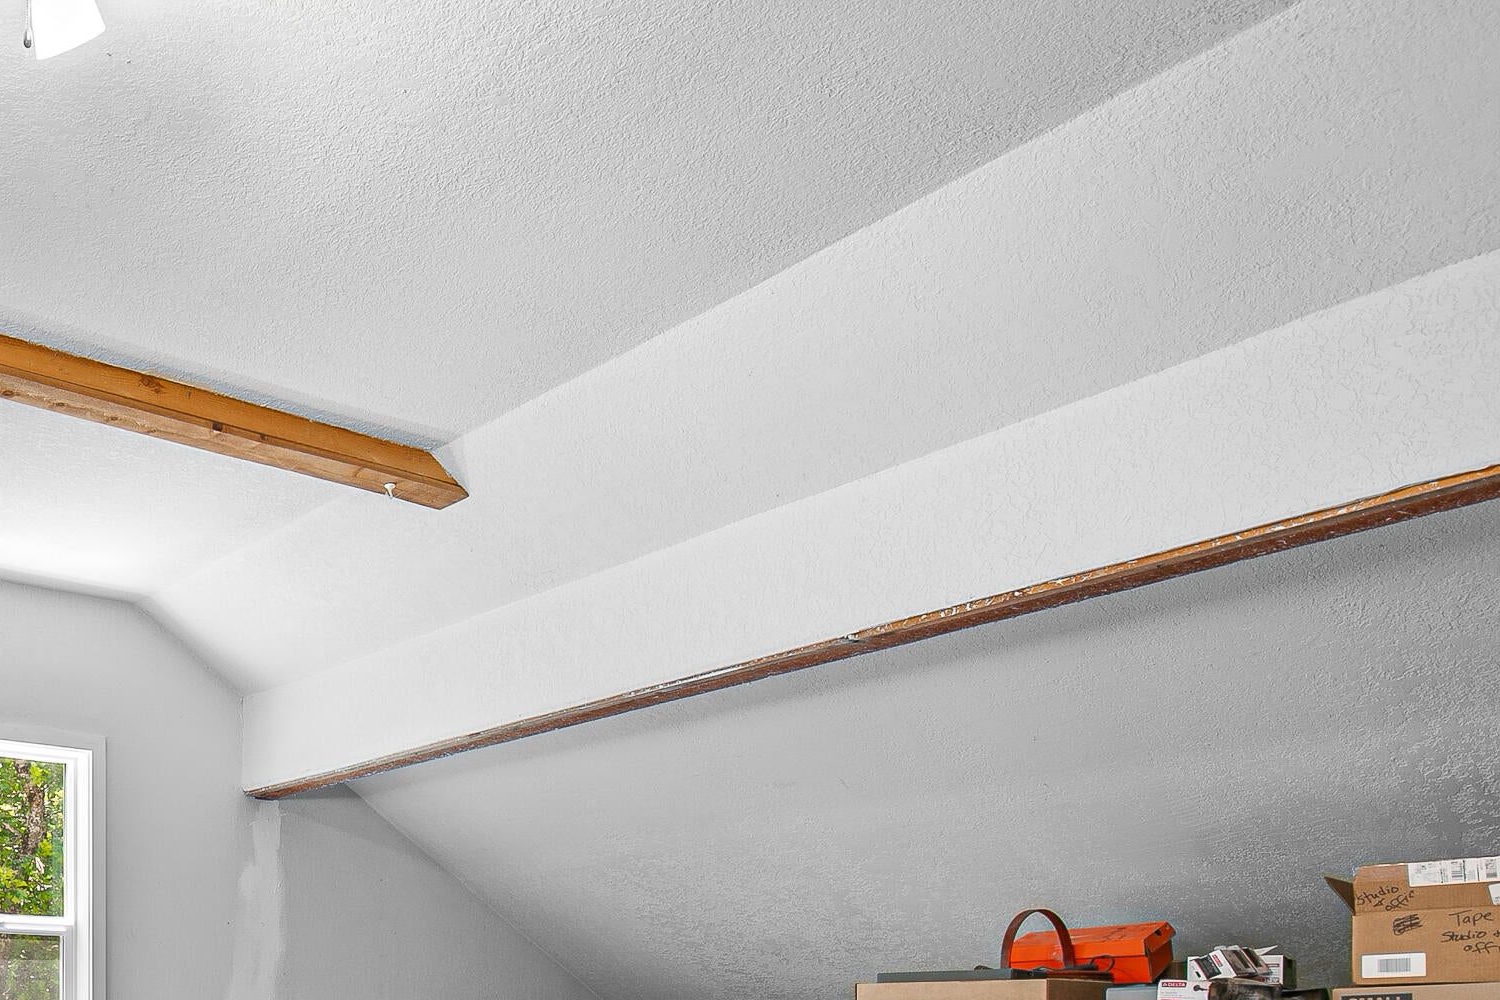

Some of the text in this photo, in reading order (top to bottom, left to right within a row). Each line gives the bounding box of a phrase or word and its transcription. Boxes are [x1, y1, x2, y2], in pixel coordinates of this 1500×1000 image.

[1356, 885, 1399, 906] Studio
[1448, 909, 1494, 926] Tape
[1441, 930, 1487, 943] Studio
